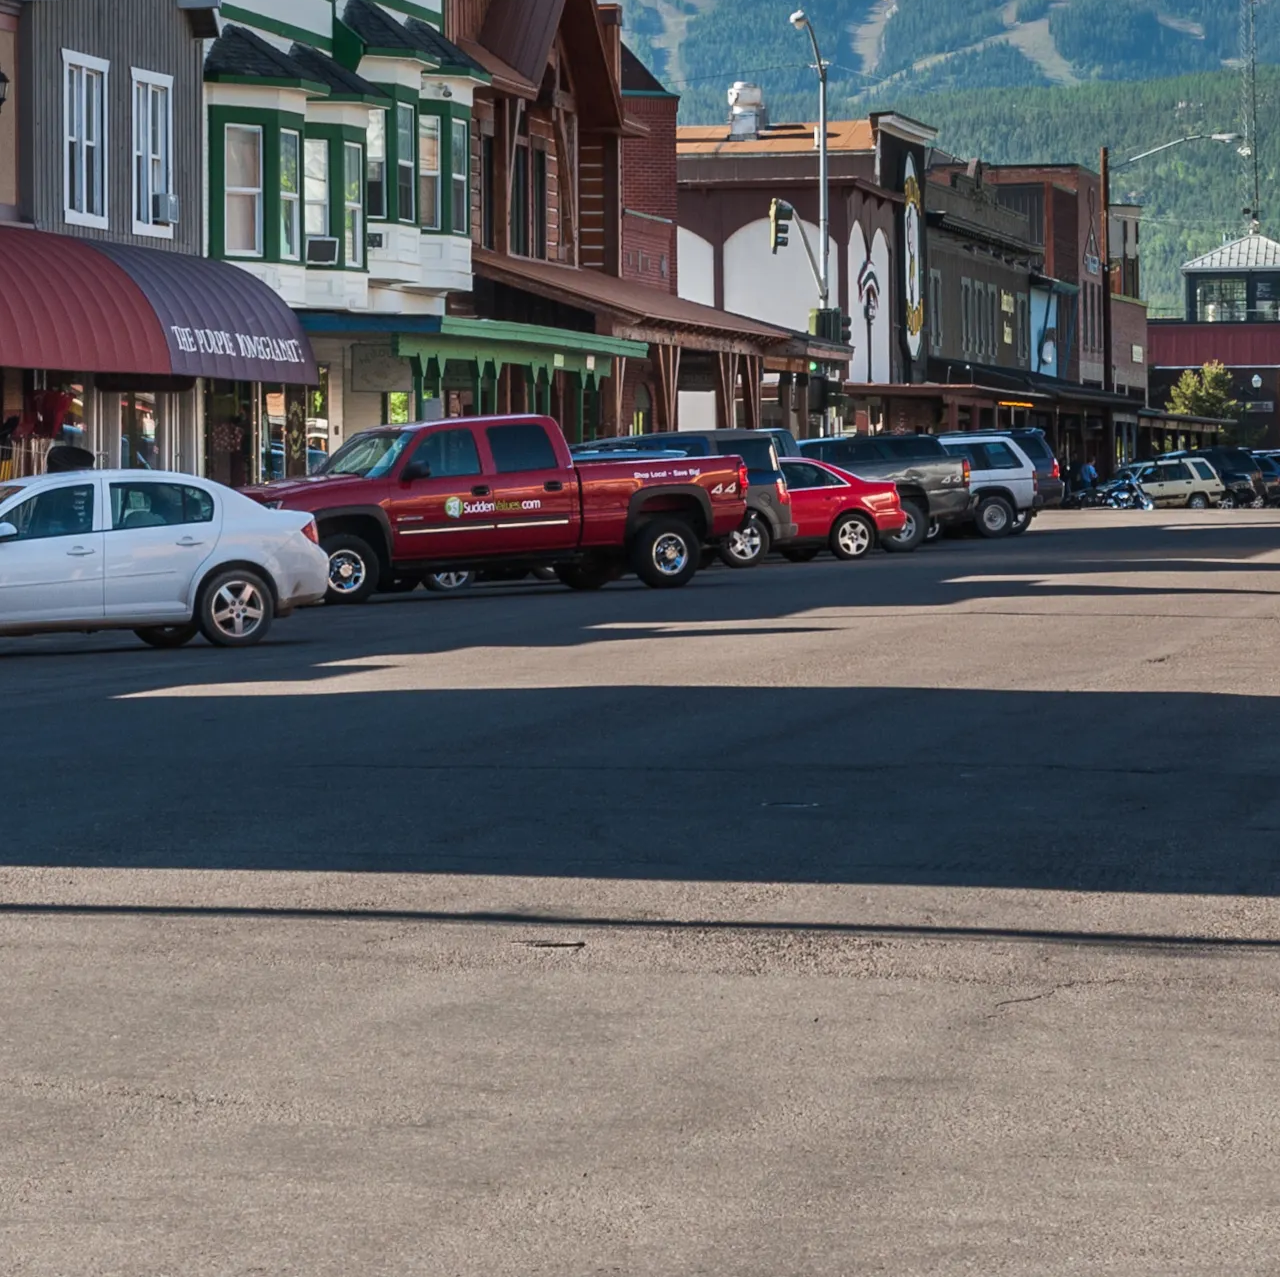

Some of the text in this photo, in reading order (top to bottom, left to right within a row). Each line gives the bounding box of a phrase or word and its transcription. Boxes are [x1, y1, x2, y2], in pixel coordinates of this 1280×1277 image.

[171, 325, 197, 352] THE
[633, 471, 650, 479] Shop
[650, 470, 667, 479] Local
[673, 469, 688, 477] Save
[688, 468, 700, 477] Big!
[463, 500, 541, 513] SuddenValues.com
